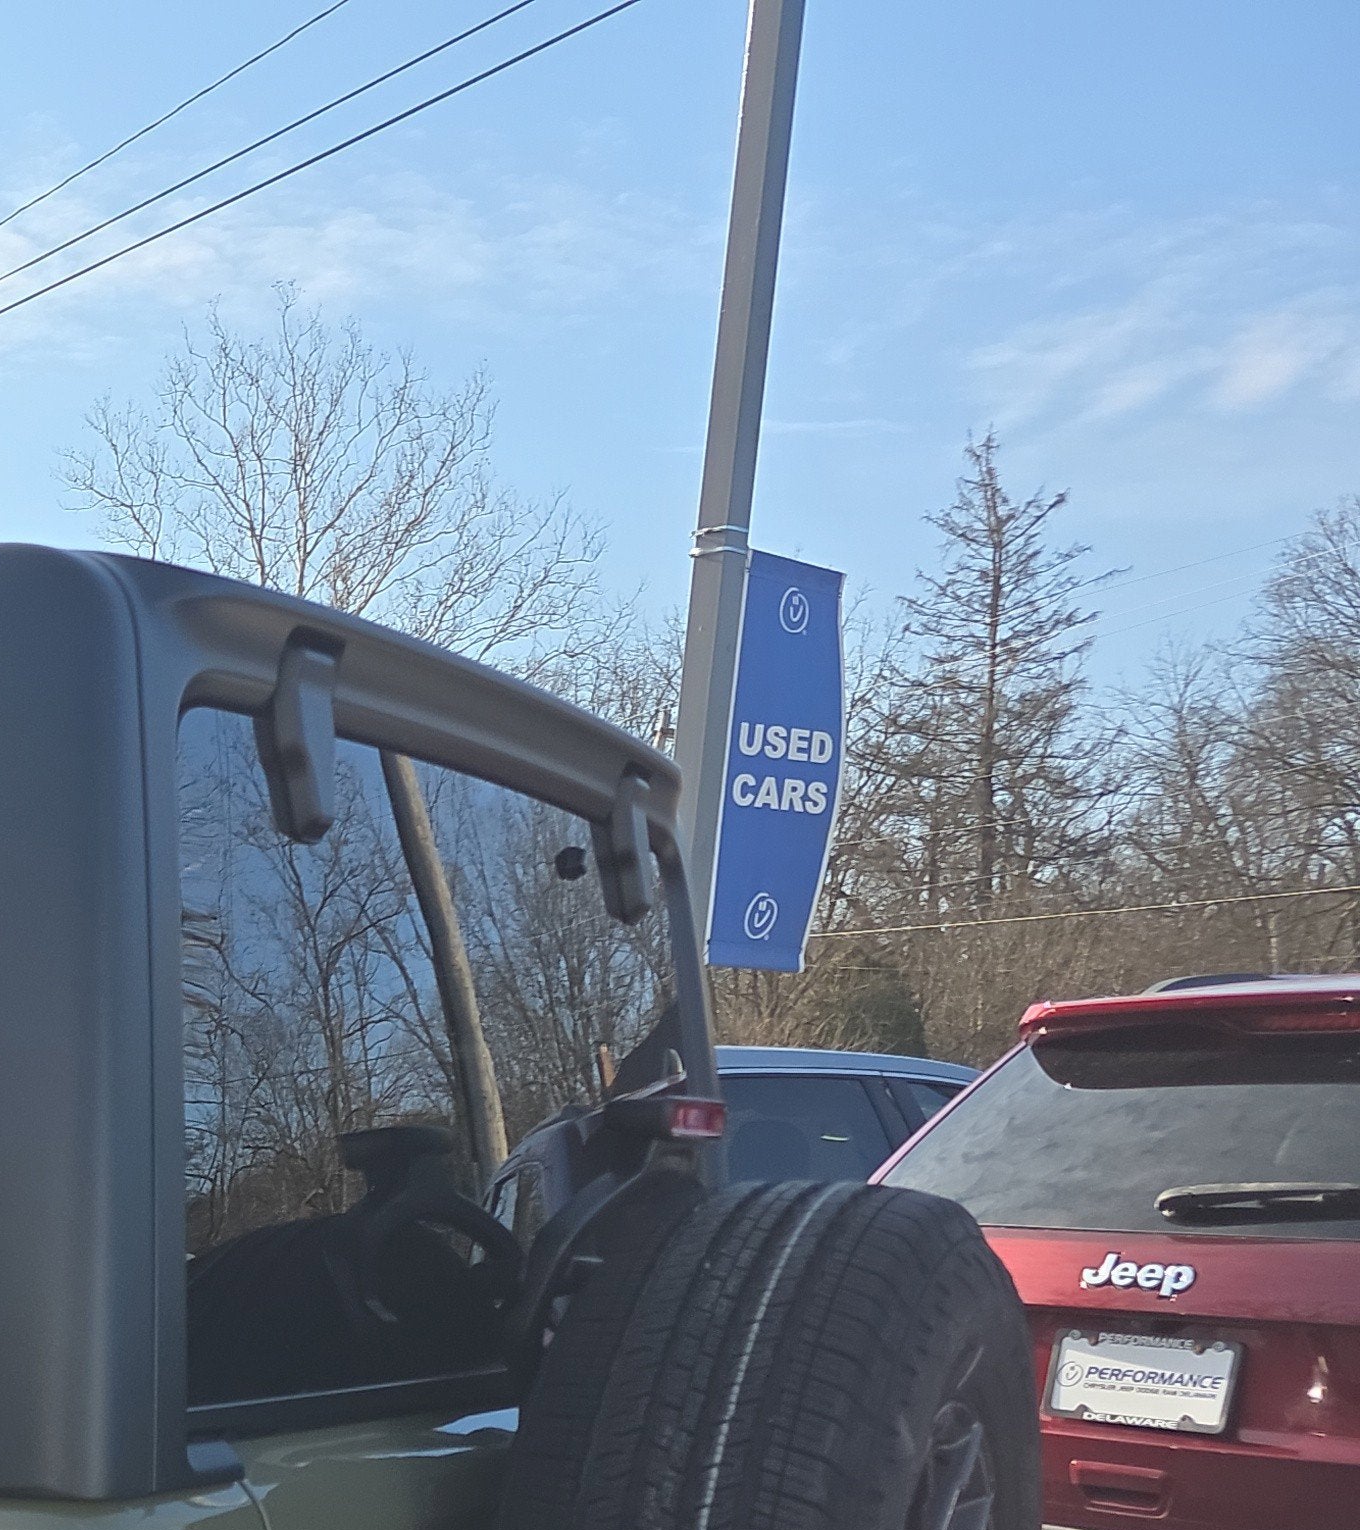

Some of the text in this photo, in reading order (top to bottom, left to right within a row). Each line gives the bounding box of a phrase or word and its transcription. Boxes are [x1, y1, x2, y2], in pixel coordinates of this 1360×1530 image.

[738, 722, 833, 764] USED
[732, 775, 828, 815] CARS
[1081, 1252, 1196, 1299] Jeep
[1098, 1332, 1195, 1349] PERFORMANCE
[1085, 1366, 1225, 1389] PERFORMANCE
[1082, 1411, 1179, 1429] DELAWARE
